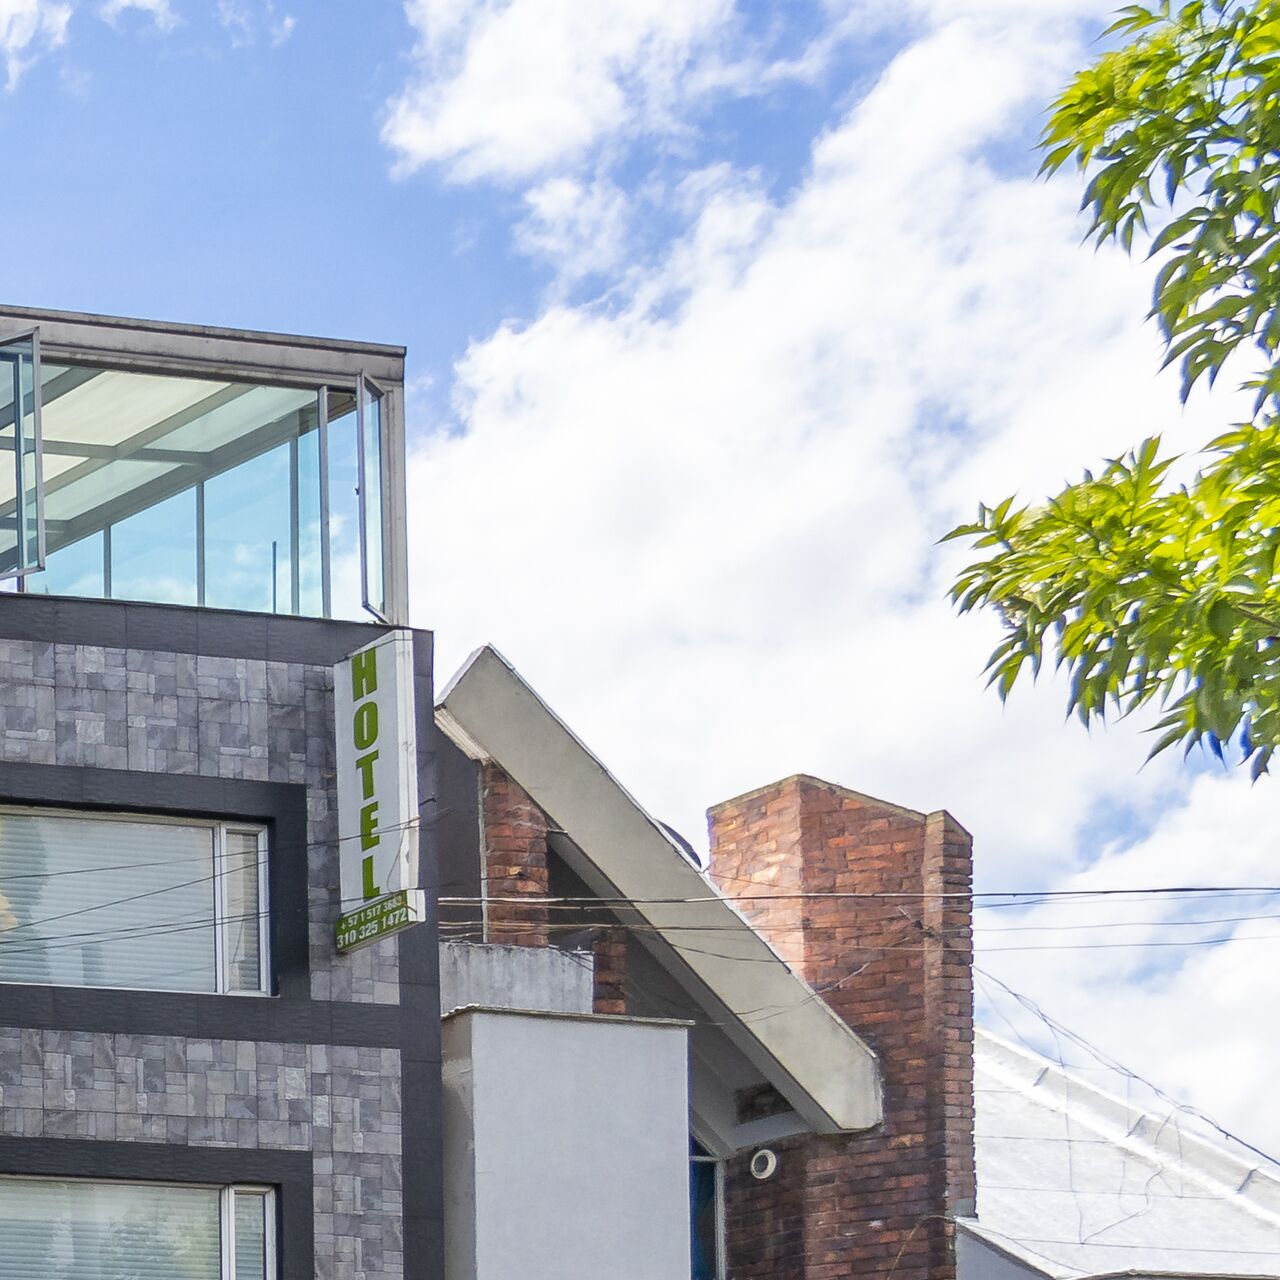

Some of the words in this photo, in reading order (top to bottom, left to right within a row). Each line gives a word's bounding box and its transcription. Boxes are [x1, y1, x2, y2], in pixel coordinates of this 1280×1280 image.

[351, 646, 381, 902] HOTEL
[336, 930, 356, 948] 310
[359, 920, 378, 939] 325
[382, 907, 407, 929] 1472
[366, 904, 381, 919] 517
